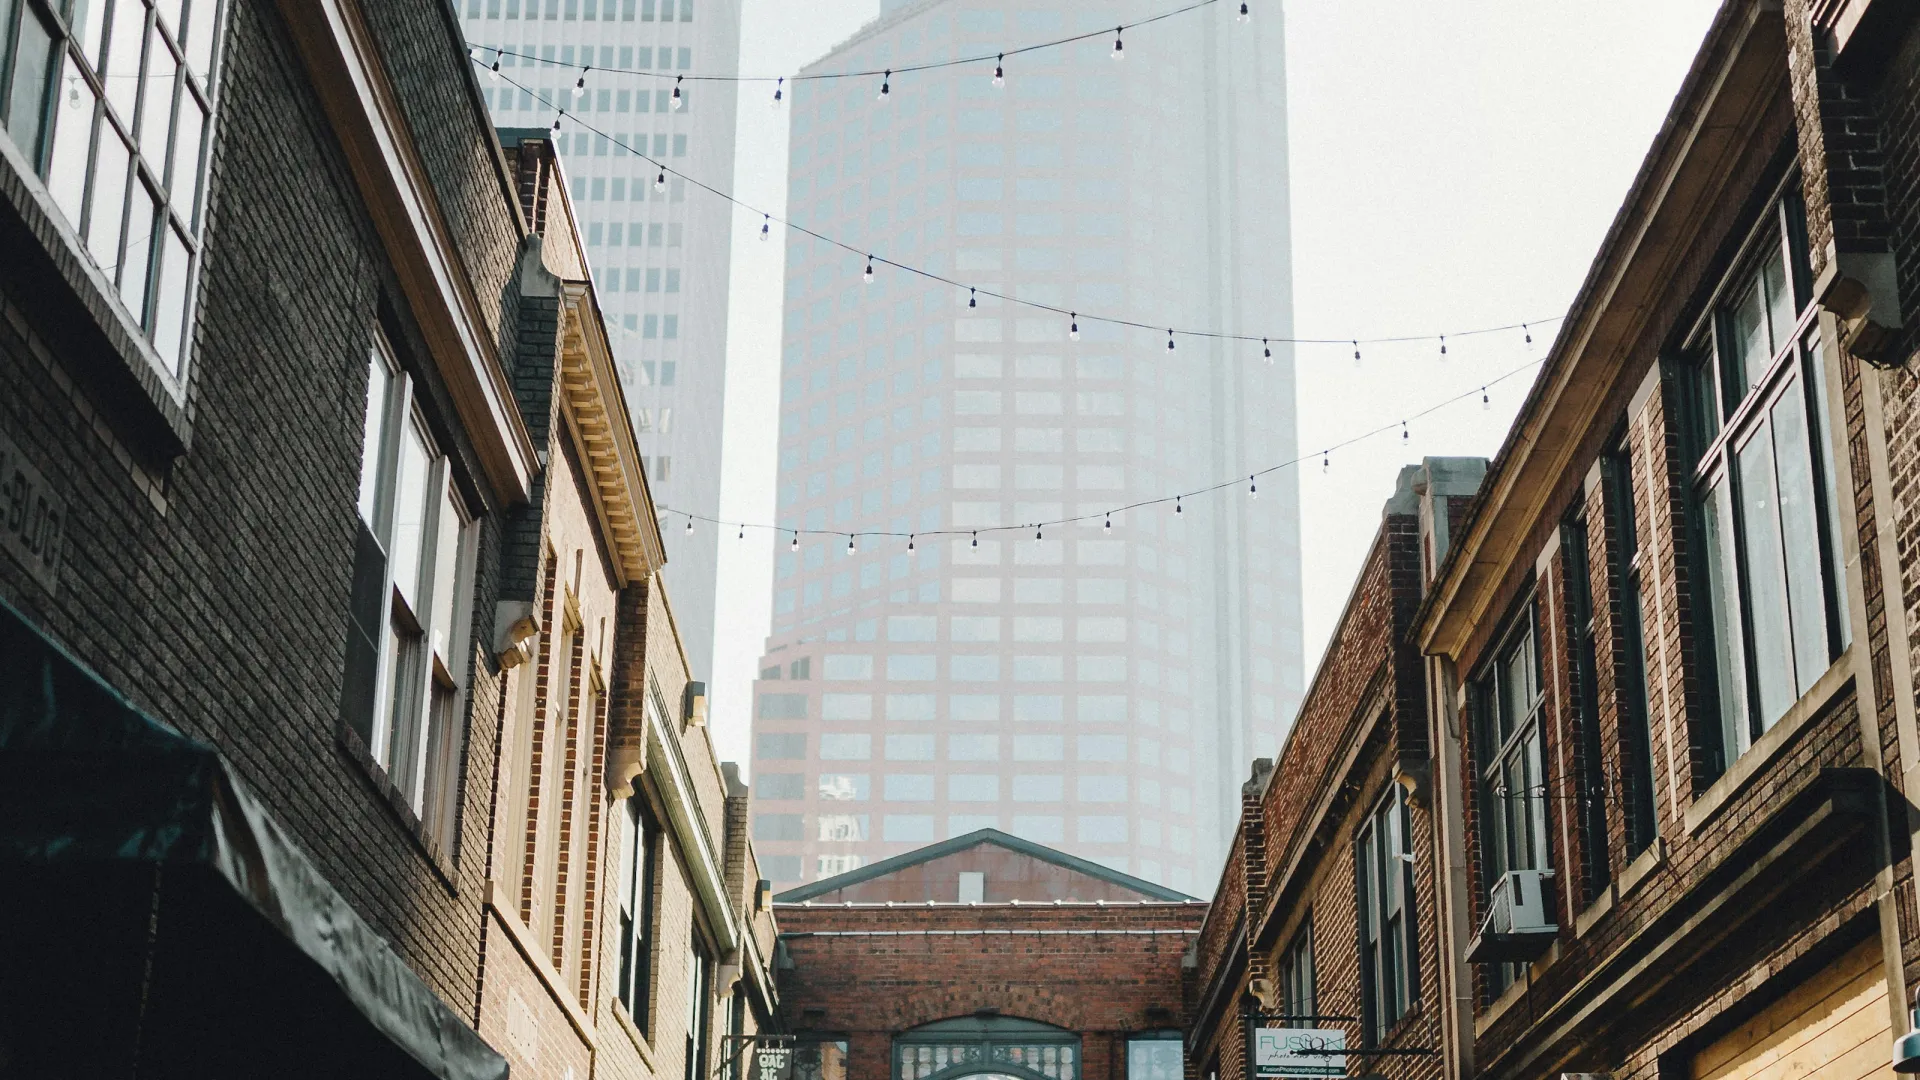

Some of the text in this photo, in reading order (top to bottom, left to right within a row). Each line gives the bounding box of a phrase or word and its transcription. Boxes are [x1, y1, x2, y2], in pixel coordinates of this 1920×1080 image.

[1260, 1035, 1343, 1050] FUSION
[1268, 1050, 1290, 1061] photo
[1262, 1066, 1341, 1074] FusionPhotographyStudiocom
